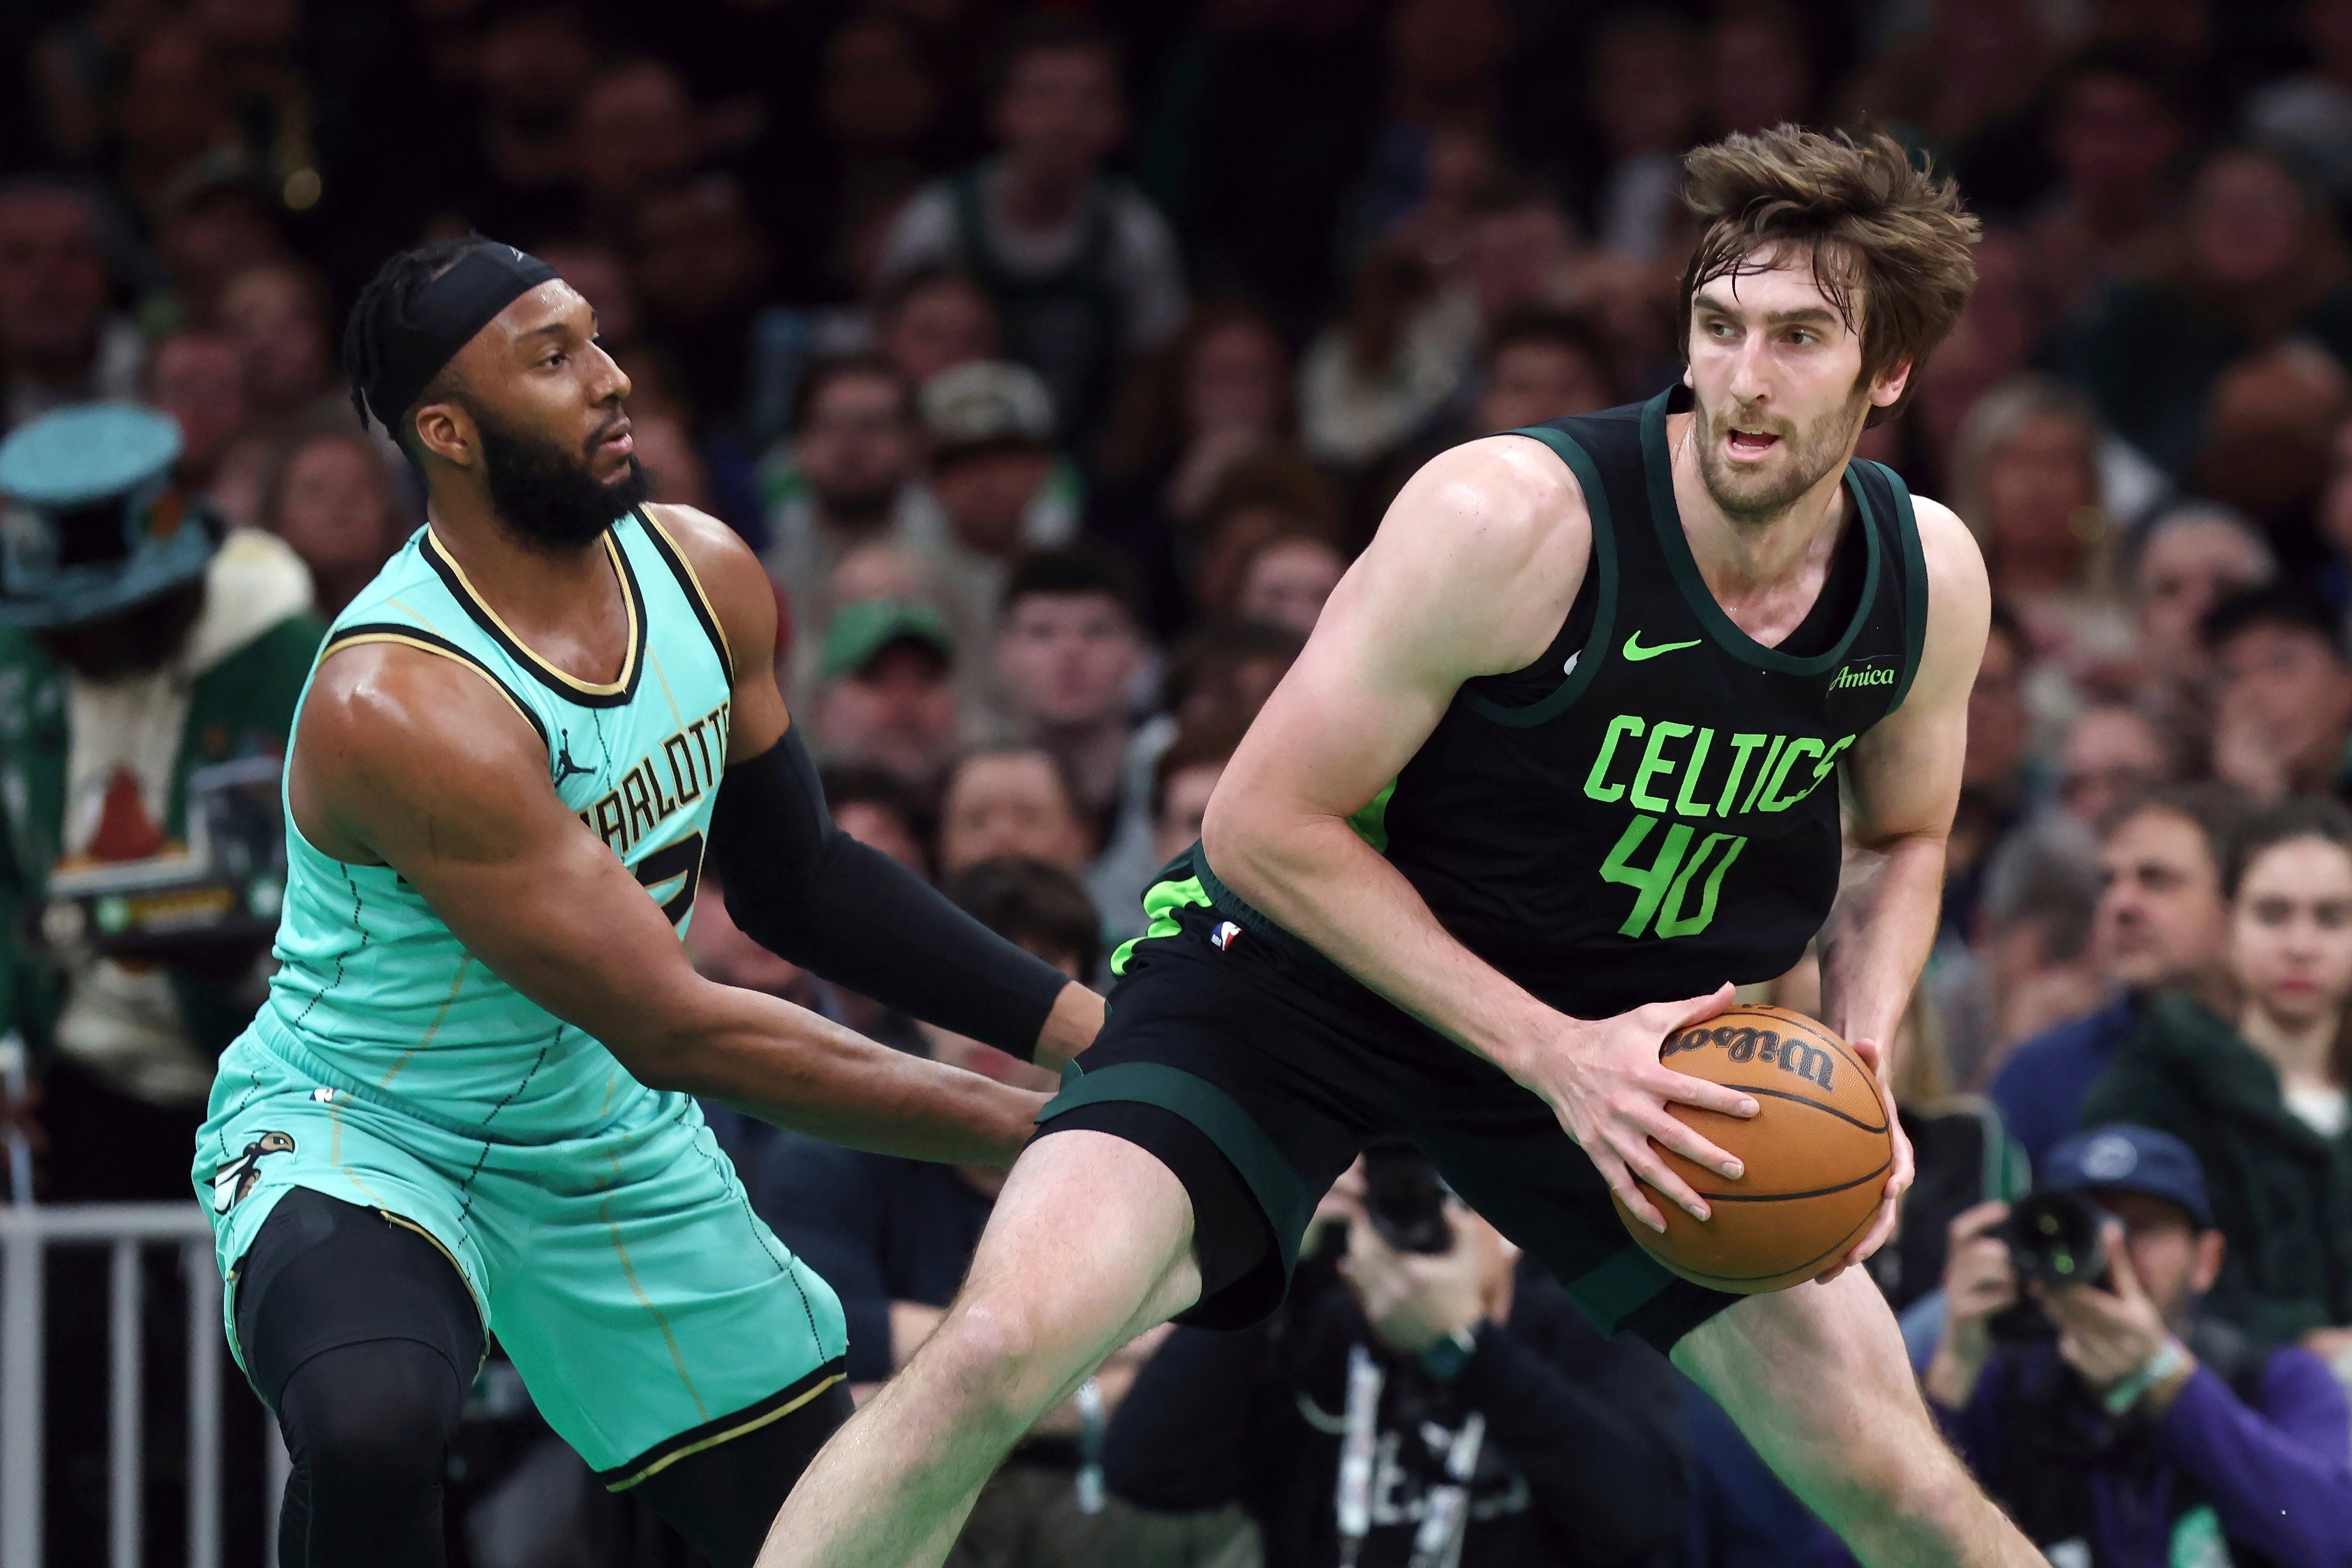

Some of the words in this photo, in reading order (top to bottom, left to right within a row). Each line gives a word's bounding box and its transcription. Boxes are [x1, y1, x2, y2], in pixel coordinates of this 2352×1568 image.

[1829, 663, 1895, 691] Amica
[579, 700, 730, 857] ARLOTT
[1583, 714, 1856, 818] CELTICS
[1599, 814, 1748, 939] 40
